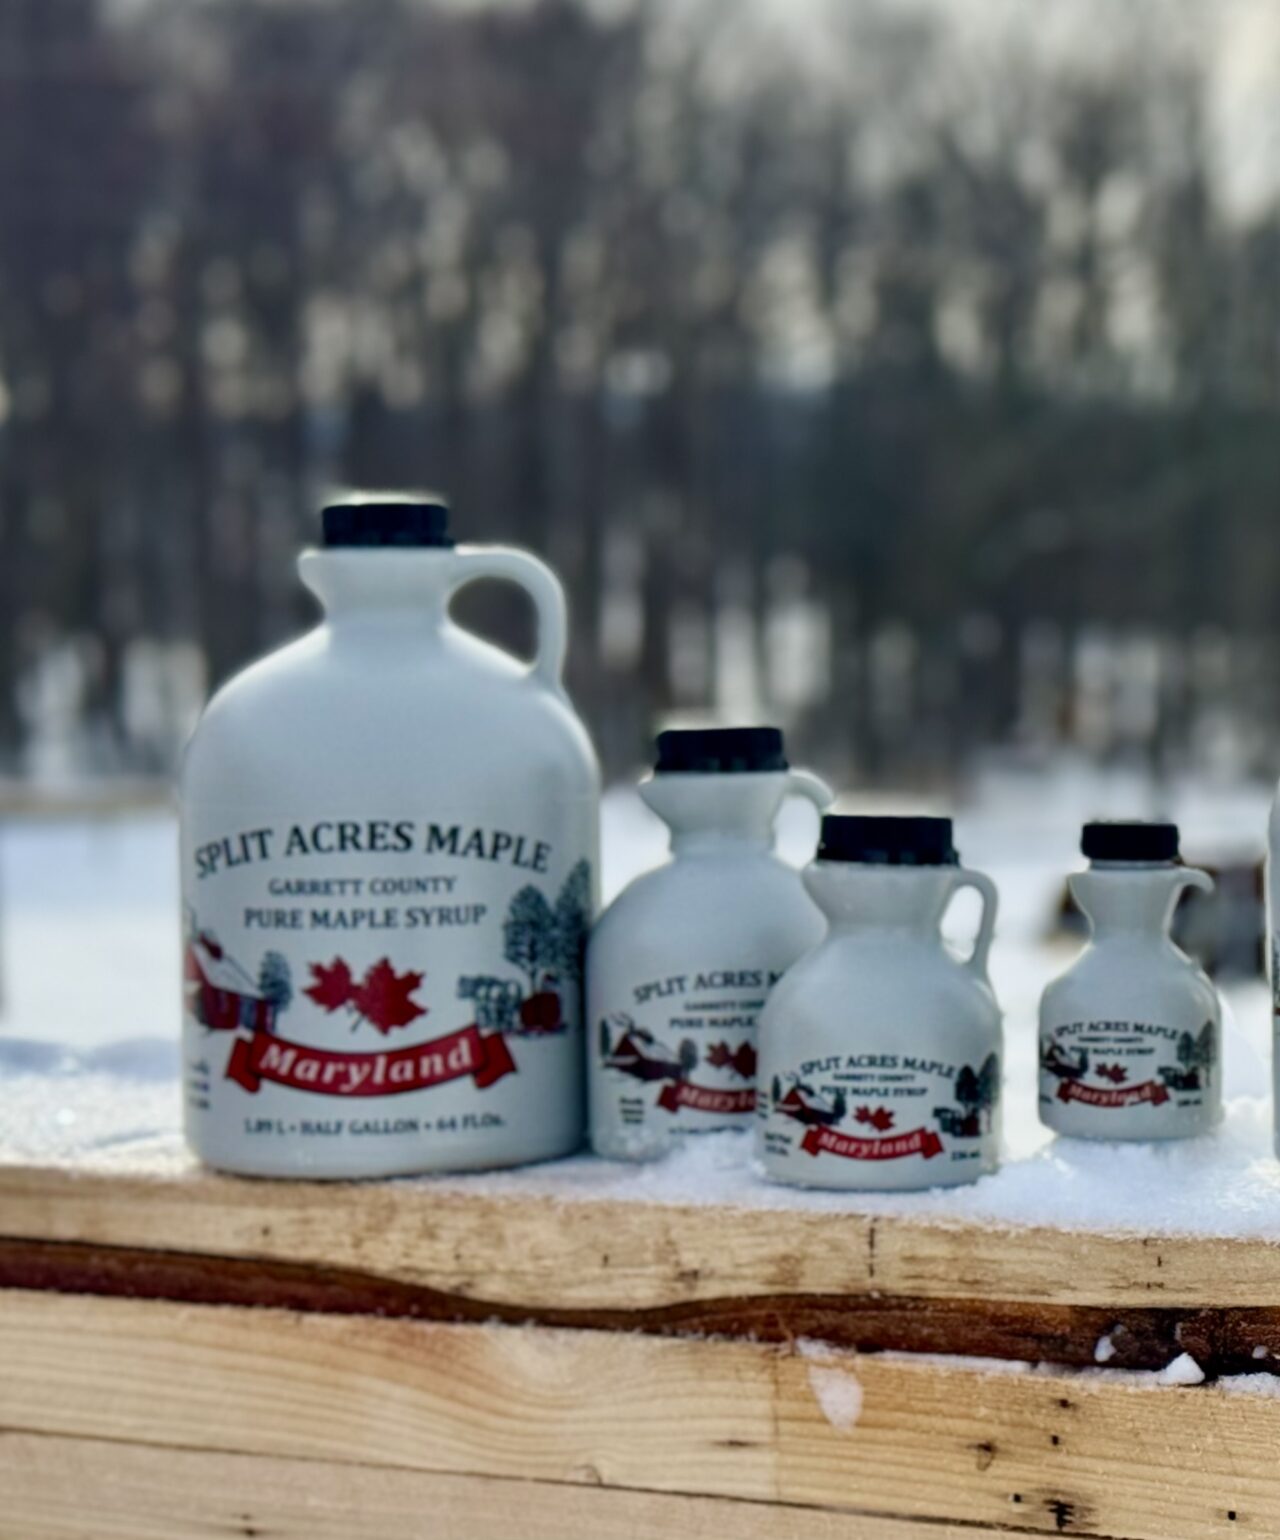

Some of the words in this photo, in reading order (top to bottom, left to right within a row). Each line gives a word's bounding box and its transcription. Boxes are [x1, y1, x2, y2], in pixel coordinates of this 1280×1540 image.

[195, 828, 273, 880] SPLIT
[284, 821, 415, 856] ACRES
[425, 824, 553, 874] MAPLE
[268, 877, 363, 897] GARRETT
[368, 876, 457, 895] COUNTY
[244, 907, 303, 930] PURE
[310, 907, 398, 930] MAPLE
[405, 905, 487, 927] SYRUP
[634, 975, 686, 1005] SPLIT
[693, 970, 763, 990] ACRES
[1087, 1020, 1129, 1032] ACRES
[1133, 1022, 1179, 1040] MAPLE
[259, 1039, 474, 1093] Maryland
[801, 1056, 841, 1077] SPLIT
[846, 1054, 898, 1069] ACRES
[902, 1056, 956, 1079] MAPLE
[349, 1118, 419, 1135] GALLON
[818, 1133, 922, 1157] Maryland
